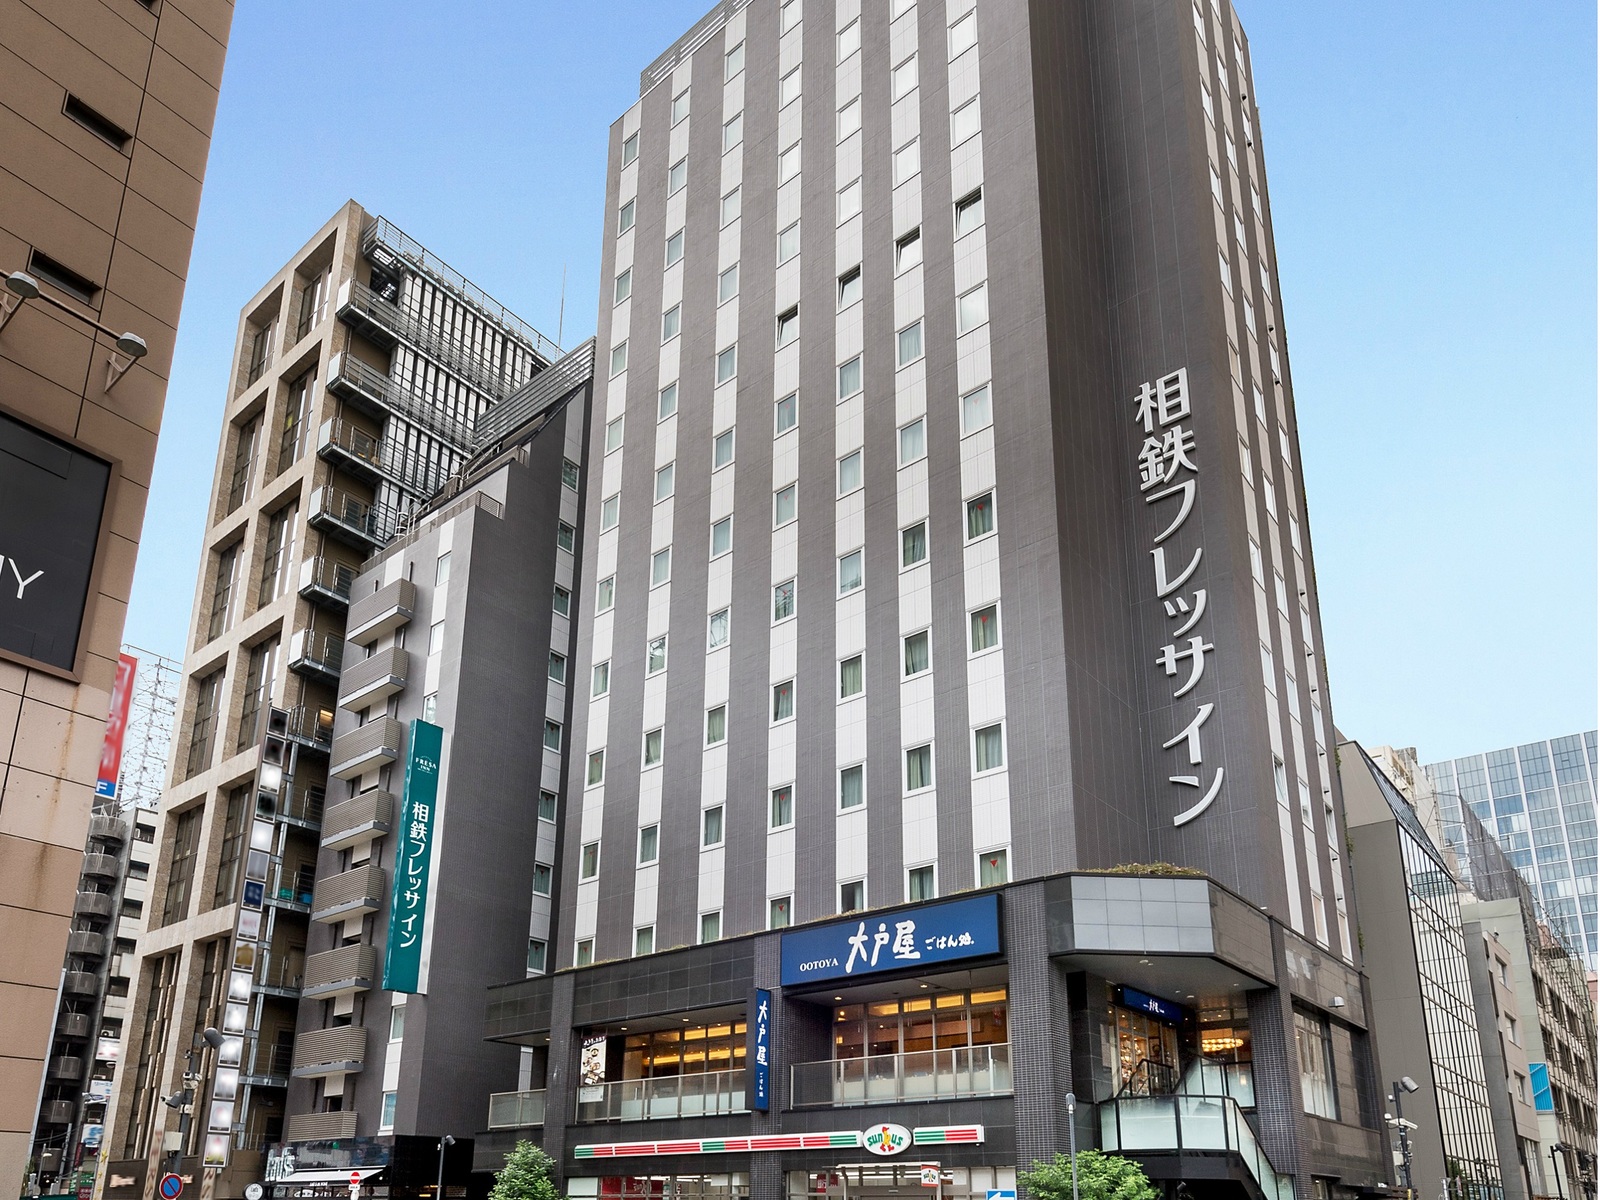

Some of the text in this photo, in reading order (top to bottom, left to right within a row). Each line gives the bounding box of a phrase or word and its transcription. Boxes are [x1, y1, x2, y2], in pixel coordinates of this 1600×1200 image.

[0, 554, 45, 600] Y
[1134, 367, 1224, 827] 相鉄フレッサイン
[416, 757, 437, 770] FRESA
[400, 801, 430, 948] 相鉄フレッサイン
[799, 957, 839, 972] OOTOYA
[845, 919, 921, 974] 大戸屋
[756, 1000, 768, 1066] 大戸屋
